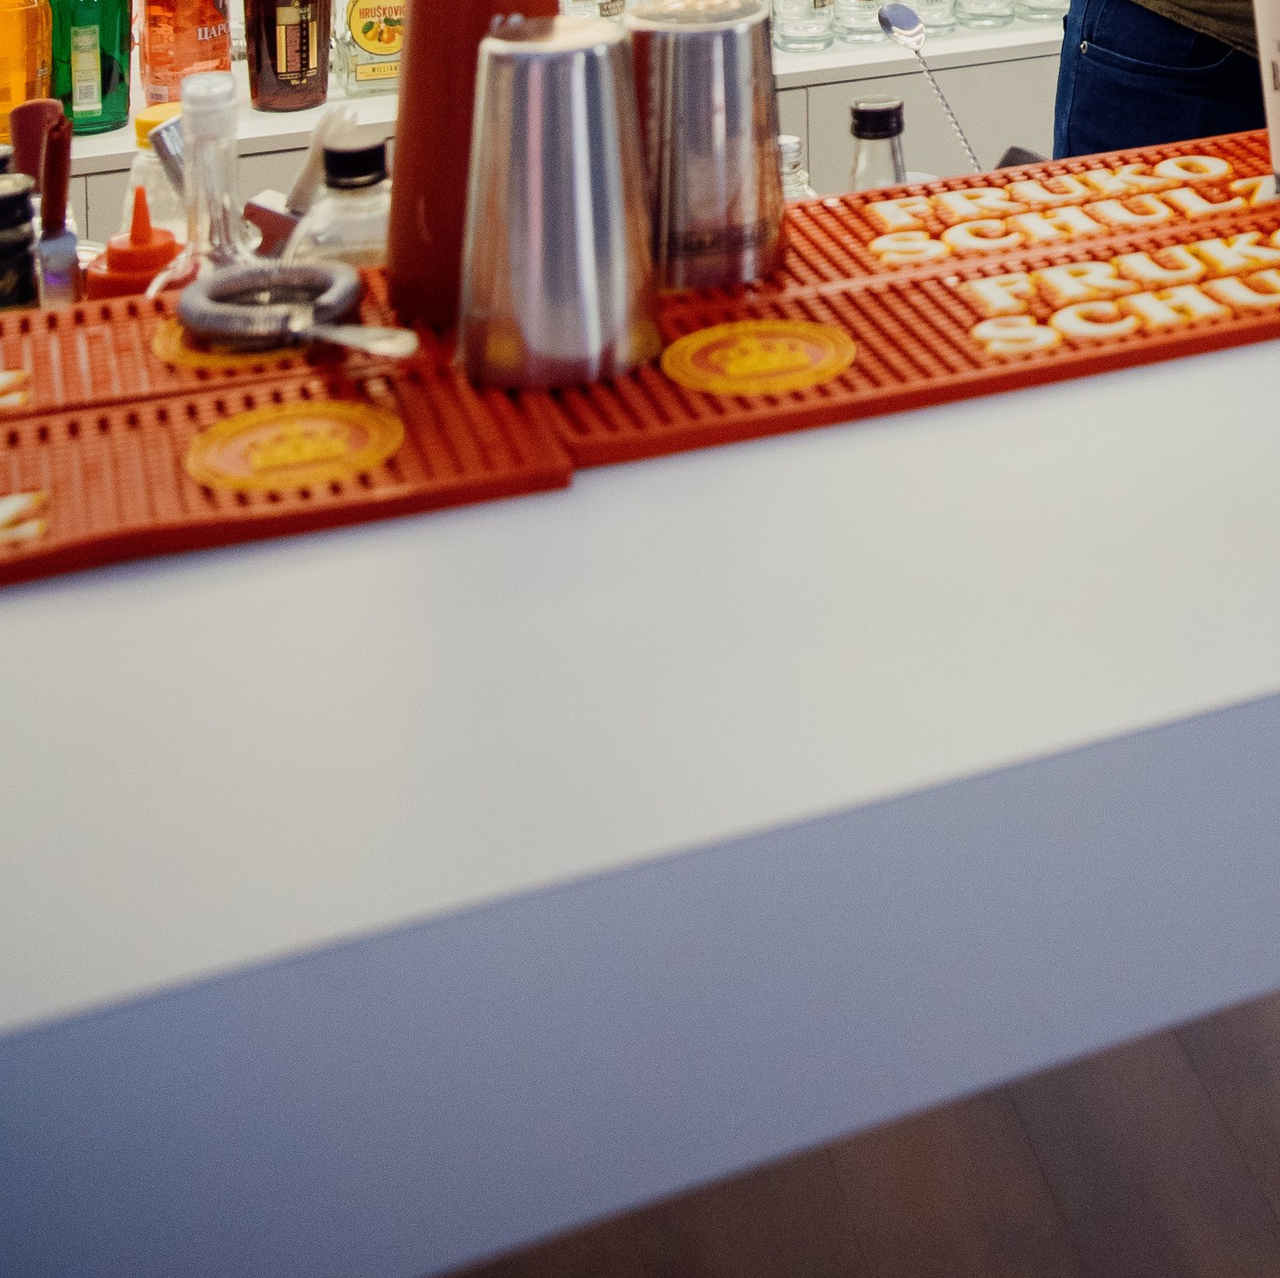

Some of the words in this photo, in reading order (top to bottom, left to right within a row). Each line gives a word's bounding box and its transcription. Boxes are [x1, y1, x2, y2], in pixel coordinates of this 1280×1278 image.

[359, 4, 406, 20] HRUŠKOVIC
[197, 23, 230, 42] ЦАРС
[371, 64, 399, 75] WILLIAM
[865, 154, 1233, 232] FRUKO
